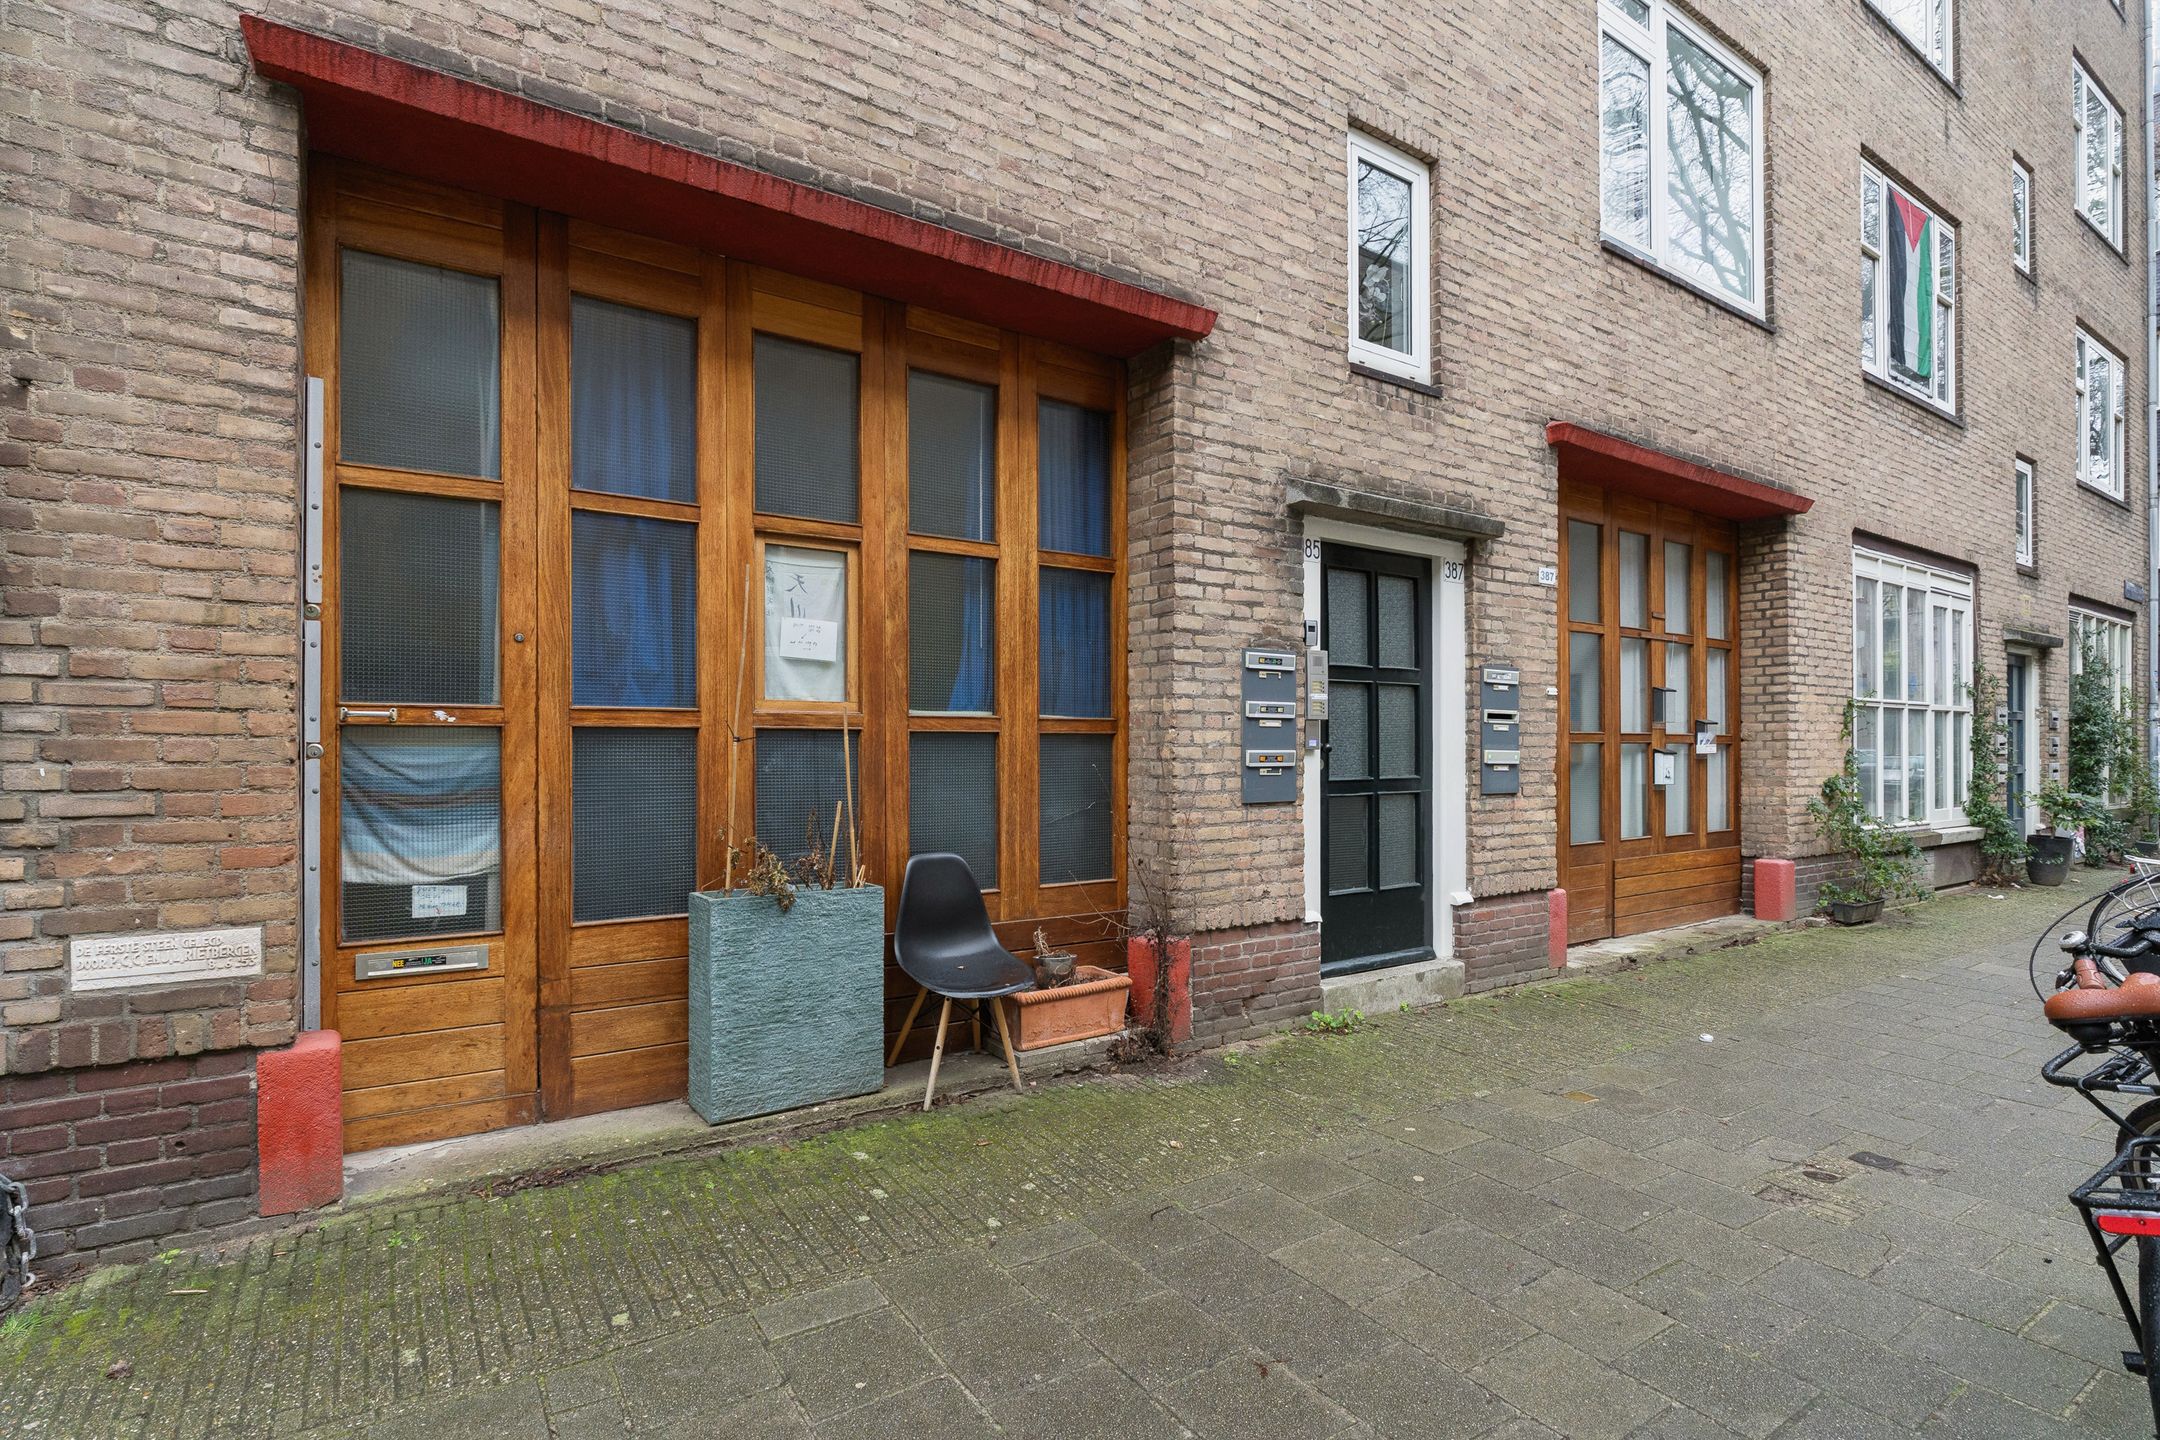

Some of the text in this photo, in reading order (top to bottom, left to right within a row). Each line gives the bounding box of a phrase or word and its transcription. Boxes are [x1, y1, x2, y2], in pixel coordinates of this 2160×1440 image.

[1445, 561, 1464, 581] 387
[1540, 570, 1555, 582] 387
[76, 946, 92, 958] DE
[95, 942, 140, 957] EERSTE
[141, 938, 178, 953] STEEN
[76, 958, 107, 971] DOOR
[184, 944, 258, 961] RIETBERGEN
[392, 959, 405, 968] NEE
